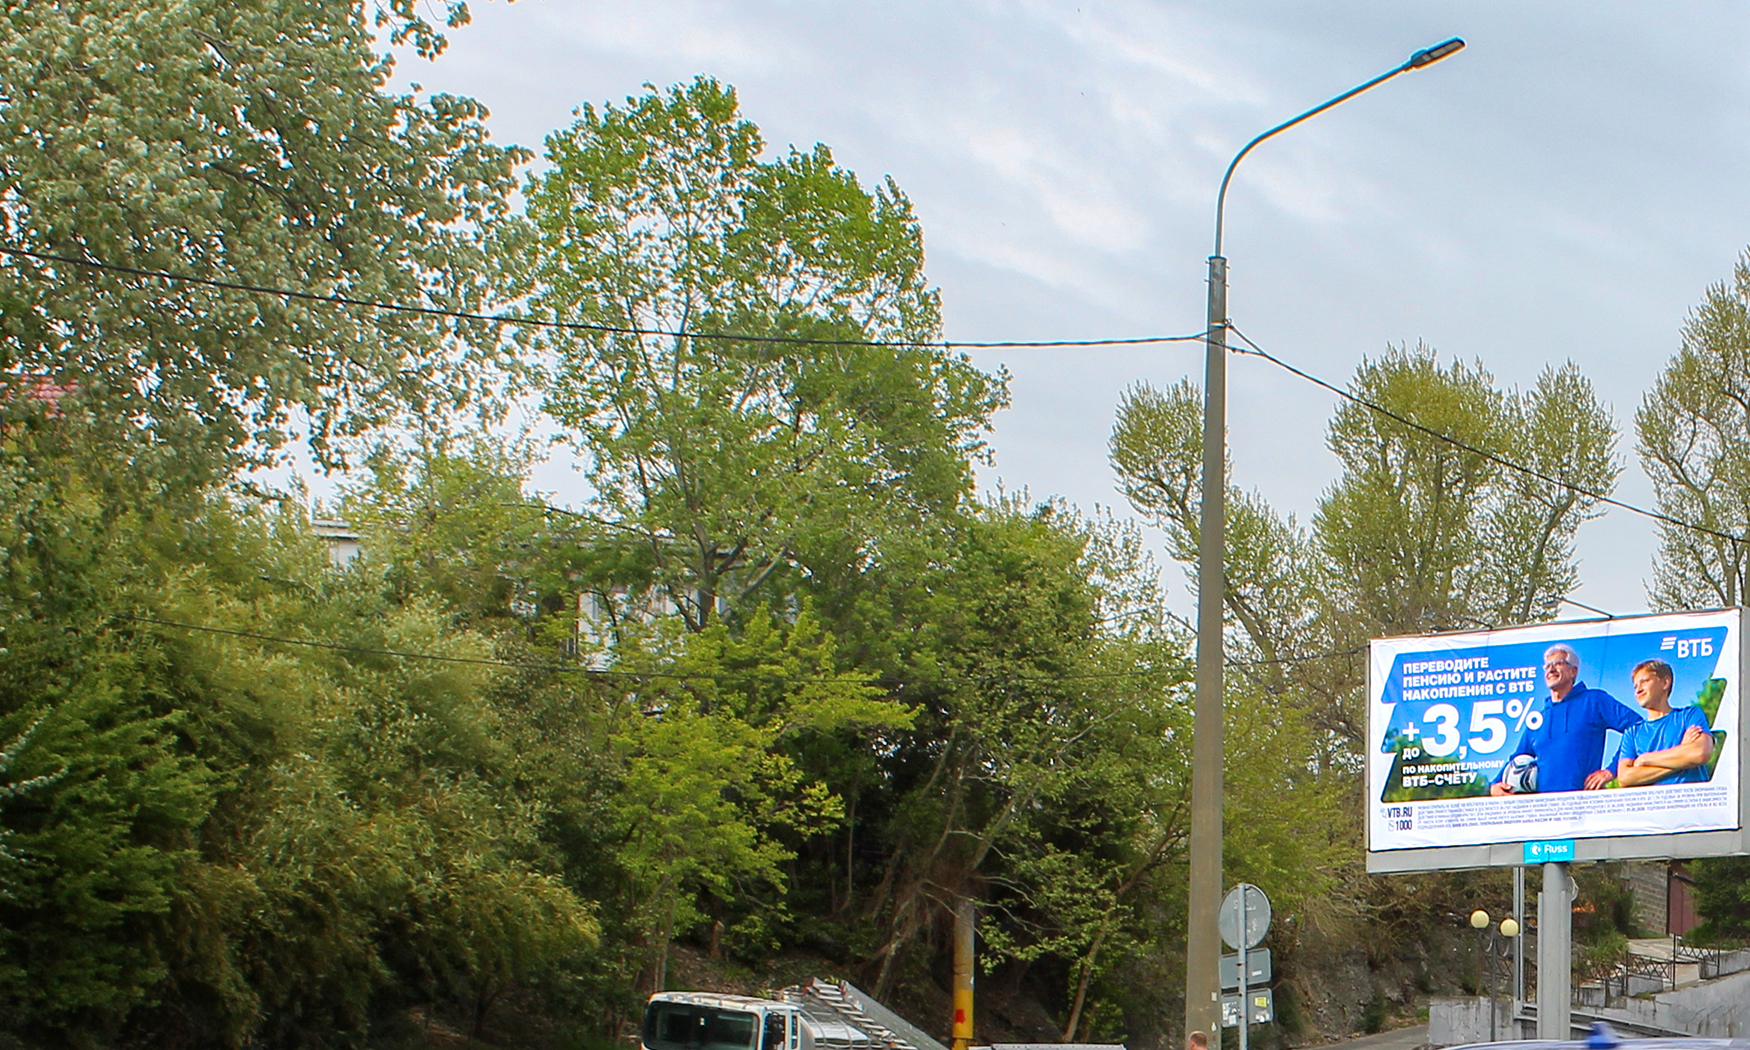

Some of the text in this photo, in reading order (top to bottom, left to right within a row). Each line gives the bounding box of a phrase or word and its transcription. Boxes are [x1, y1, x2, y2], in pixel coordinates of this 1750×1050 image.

[1677, 637, 1714, 659] ВТБ
[1403, 657, 1489, 674] ПЕРЕВОДИТЕ
[1402, 667, 1537, 688] ПЕНСИЮ И РАСТИТЕ
[1402, 680, 1535, 701] НАКОПЛЕНИЯ С ВТБ
[1402, 760, 1505, 775] ПО НАКОПИТЕЛЬНОМУ
[1402, 772, 1477, 788] ВТБ-СЧЁТУ
[1395, 819, 1413, 831] 1000
